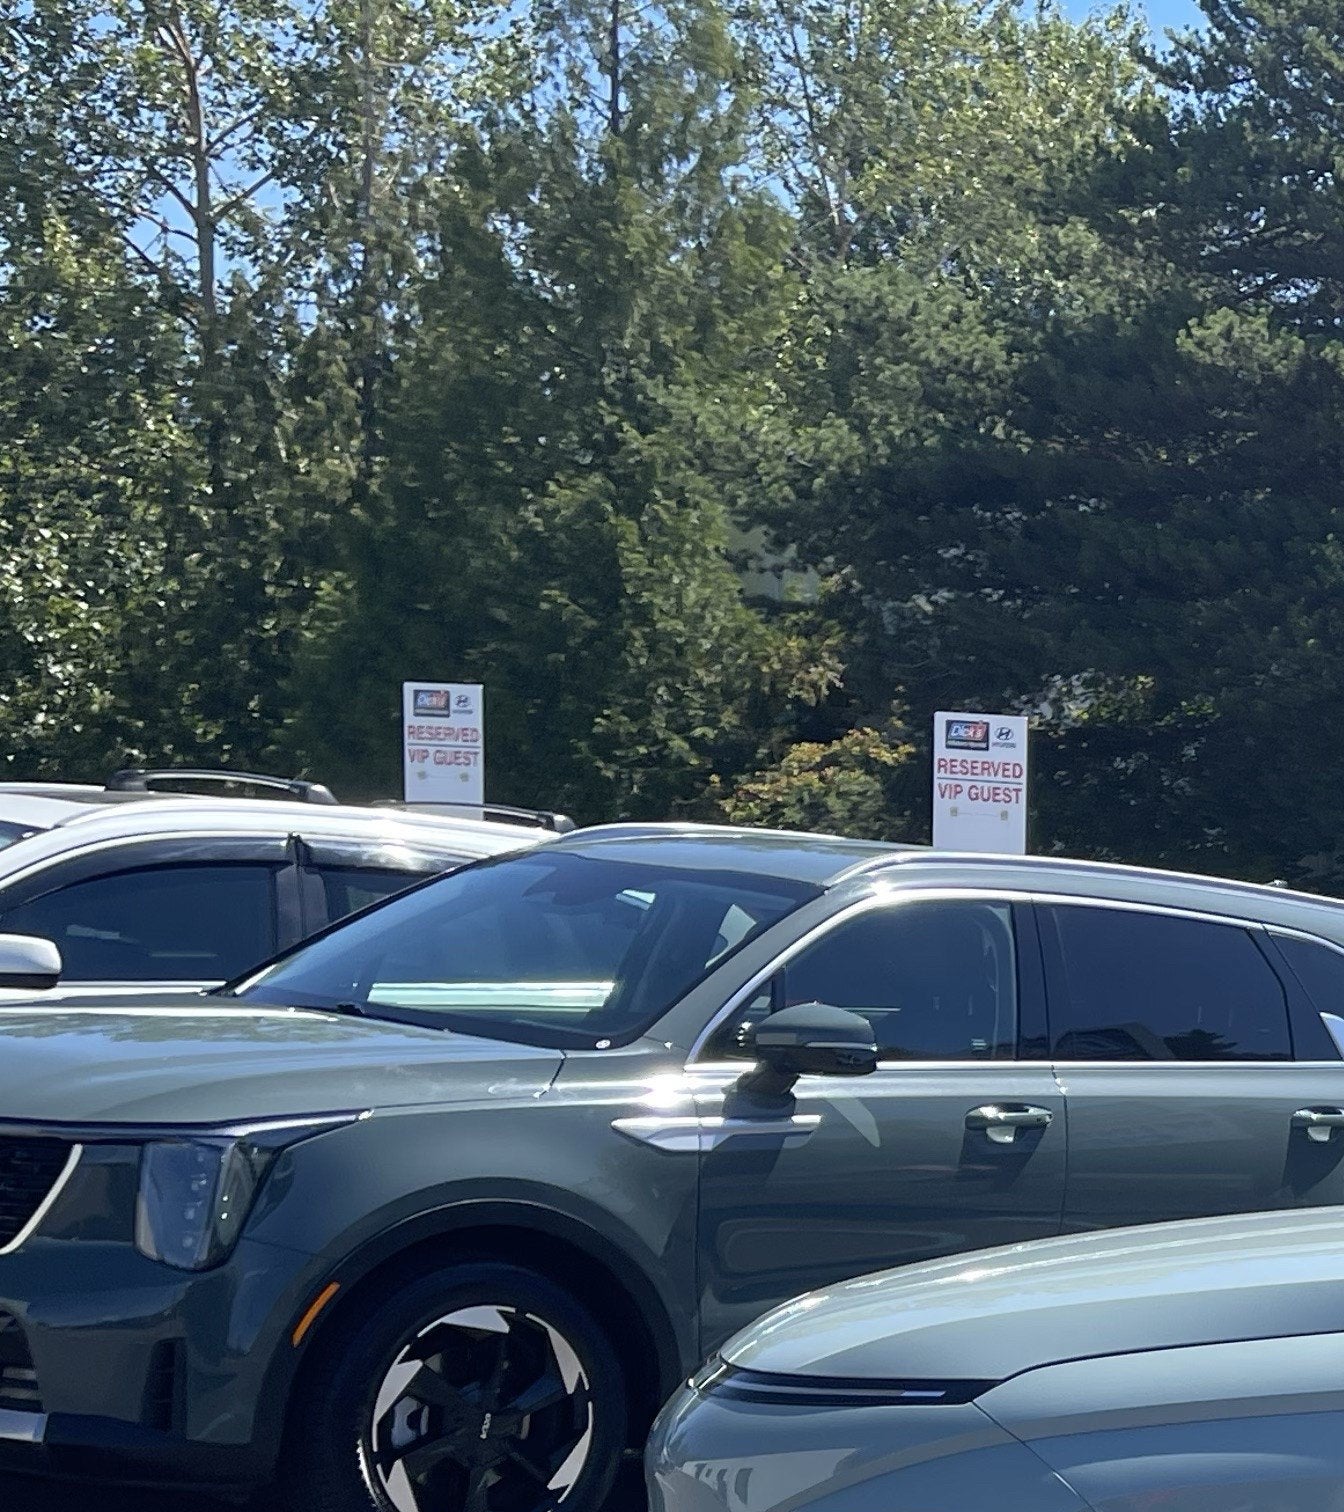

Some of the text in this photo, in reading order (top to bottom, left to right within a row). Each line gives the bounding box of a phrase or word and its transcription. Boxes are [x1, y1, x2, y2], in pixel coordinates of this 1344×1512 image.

[937, 758, 1023, 778] RESERVED
[938, 782, 1022, 804] VIP GUEST
